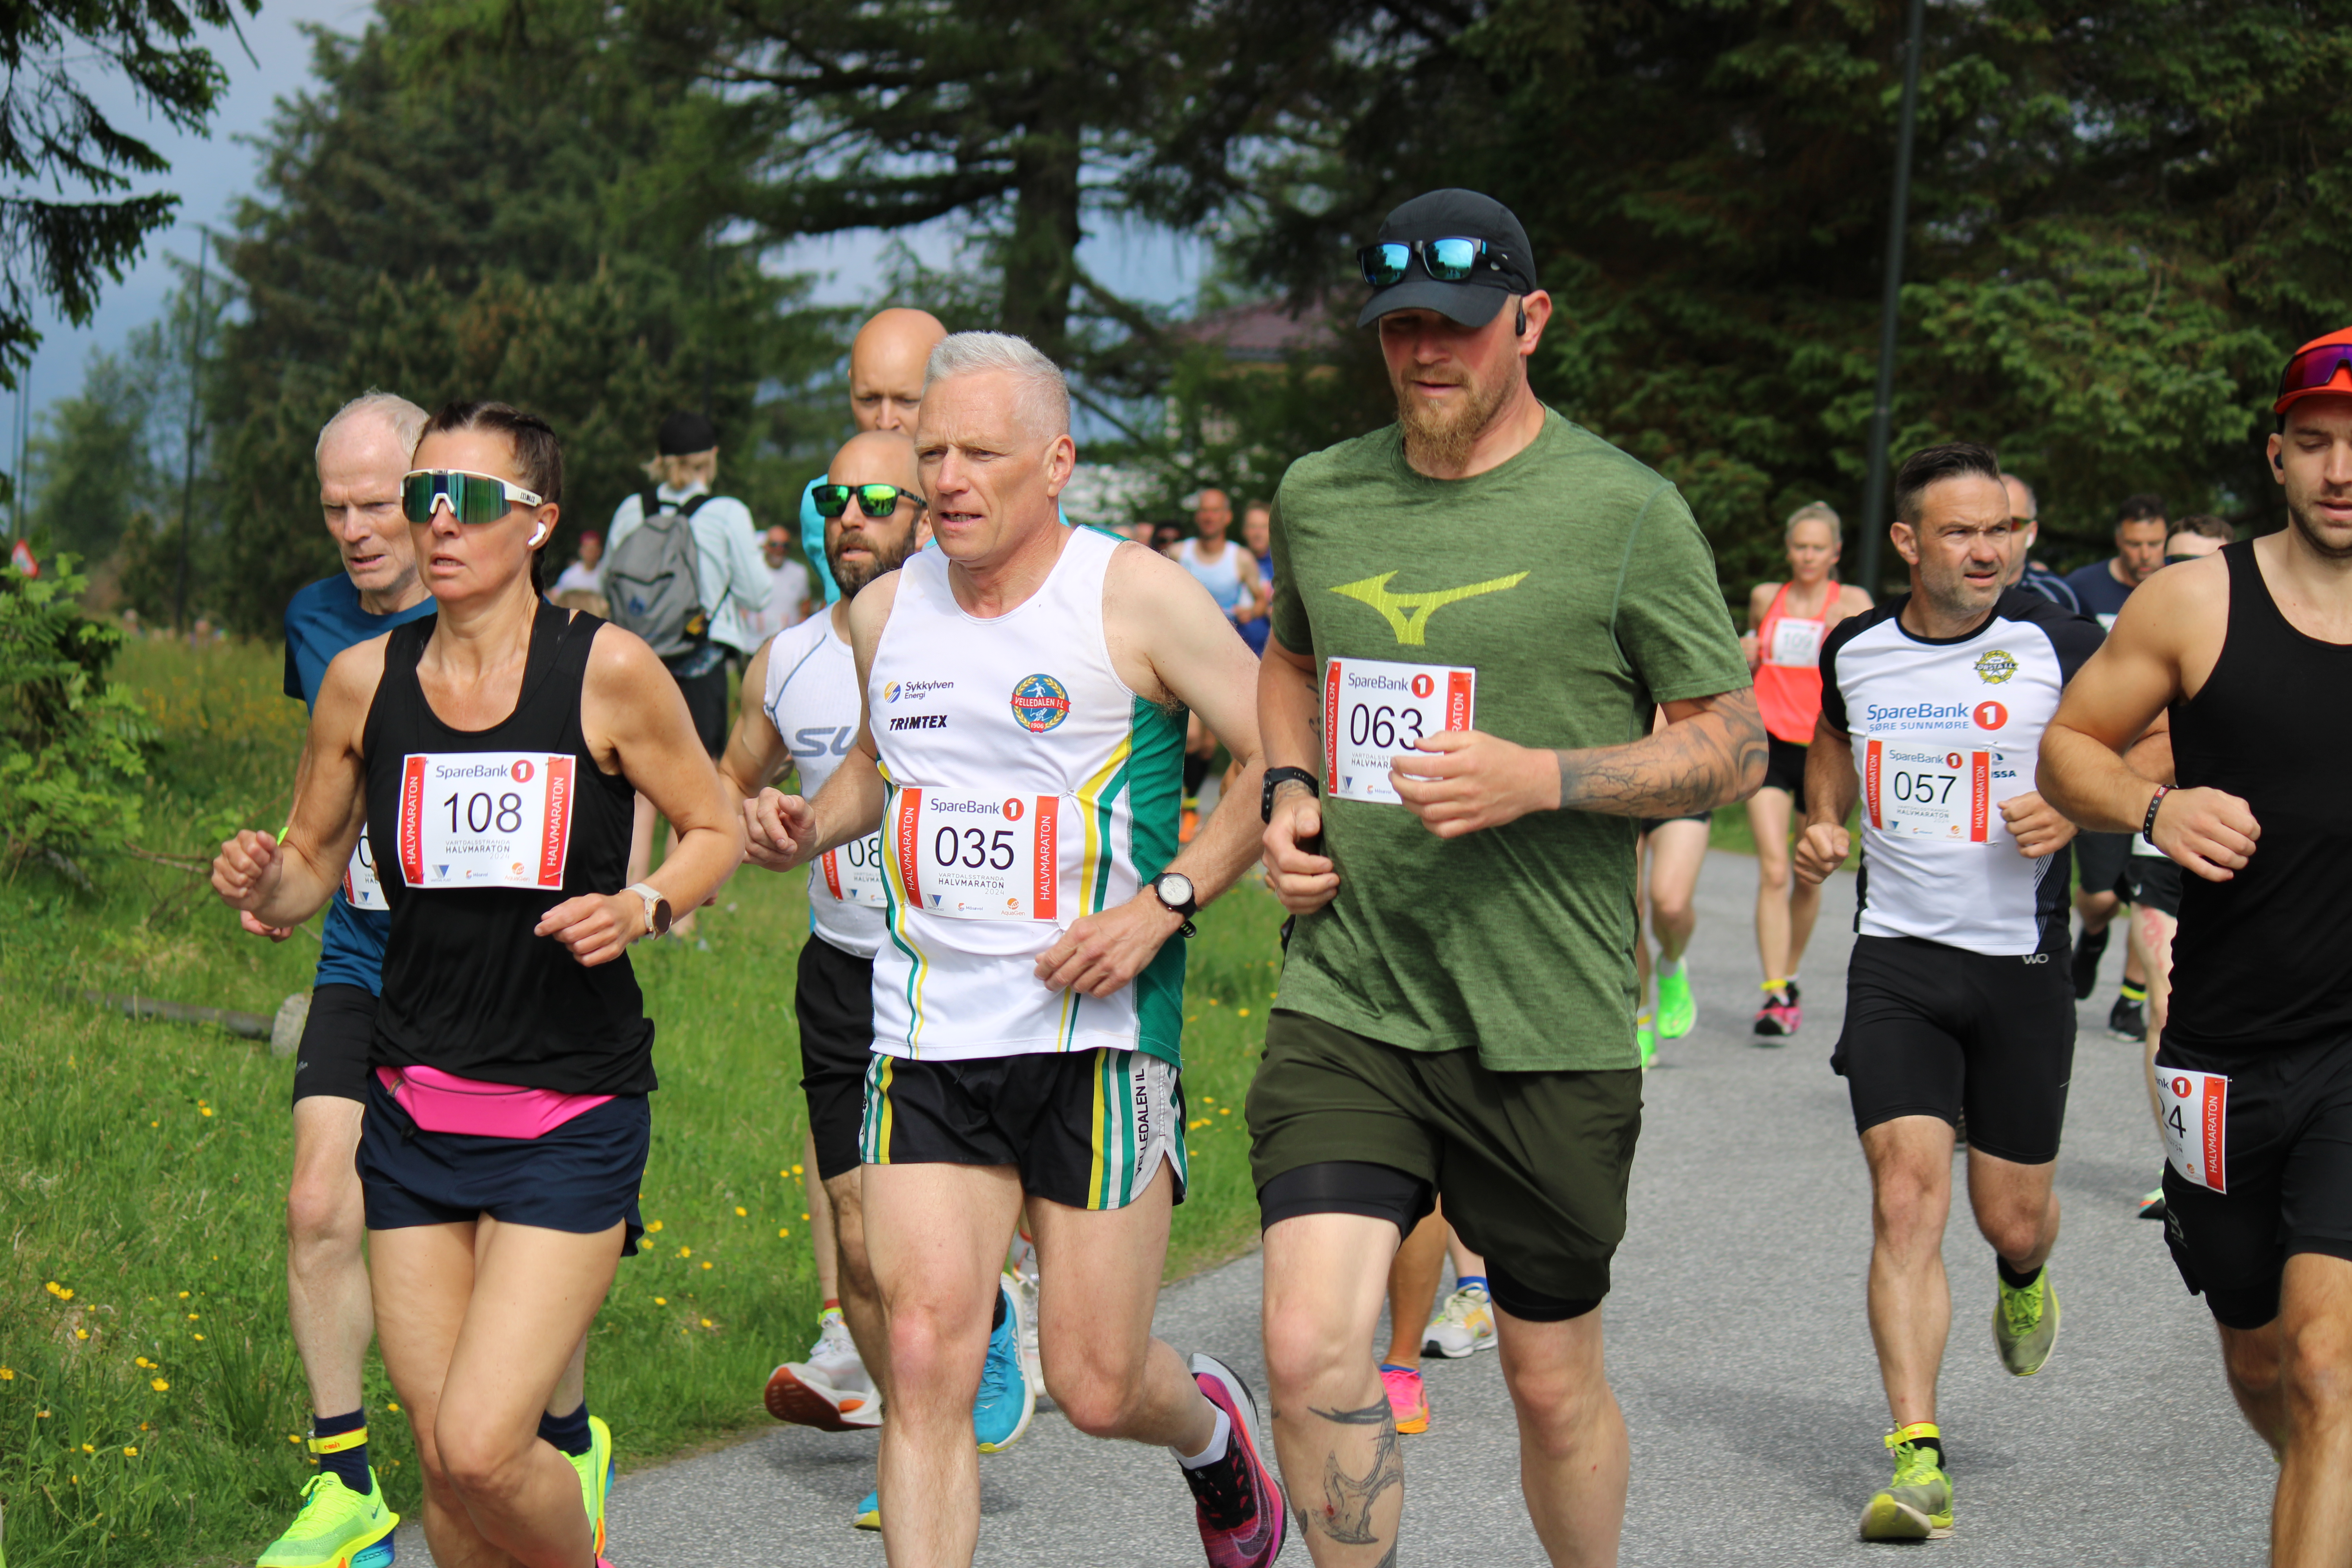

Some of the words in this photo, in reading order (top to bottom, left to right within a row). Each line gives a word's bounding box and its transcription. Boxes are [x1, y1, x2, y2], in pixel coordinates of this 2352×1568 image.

[905, 681, 954, 692] Sykkylven
[1348, 672, 1409, 691] SpareBank
[1417, 677, 1427, 695] 1
[904, 691, 926, 700] Energi
[1015, 696, 1055, 707] VELLEDALEN
[889, 714, 948, 731] TRIMTEX
[1867, 702, 1970, 722] SpareBank
[1982, 706, 1997, 725] 1
[1350, 703, 1424, 750] 063
[1869, 722, 1897, 732] SØRE
[1900, 721, 1969, 730] SUNNMØRE
[1889, 750, 1944, 764] SpareBank
[436, 765, 508, 780] SpareBank
[517, 762, 527, 780] 1
[1869, 754, 1878, 817] HALVMARATON
[1894, 771, 1957, 804] 057
[1976, 766, 1985, 828] HALVMARATON
[443, 793, 522, 833] 108
[930, 798, 1000, 815] SpareBank
[1008, 801, 1018, 818] 1
[1896, 809, 1949, 818] HALVMARATON
[407, 776, 419, 865] HALVMARATON
[546, 777, 564, 867] HALVMARATON
[445, 845, 510, 854] HALVMARATON
[903, 807, 915, 891] HALVMARATON
[935, 826, 1014, 870] 035
[1040, 816, 1051, 900] HALVMARATON
[939, 873, 1004, 881] VARTDALSSTRANDA
[939, 878, 1004, 889] HALVMARATON
[2208, 1095, 2218, 1174] HALVMARATON
